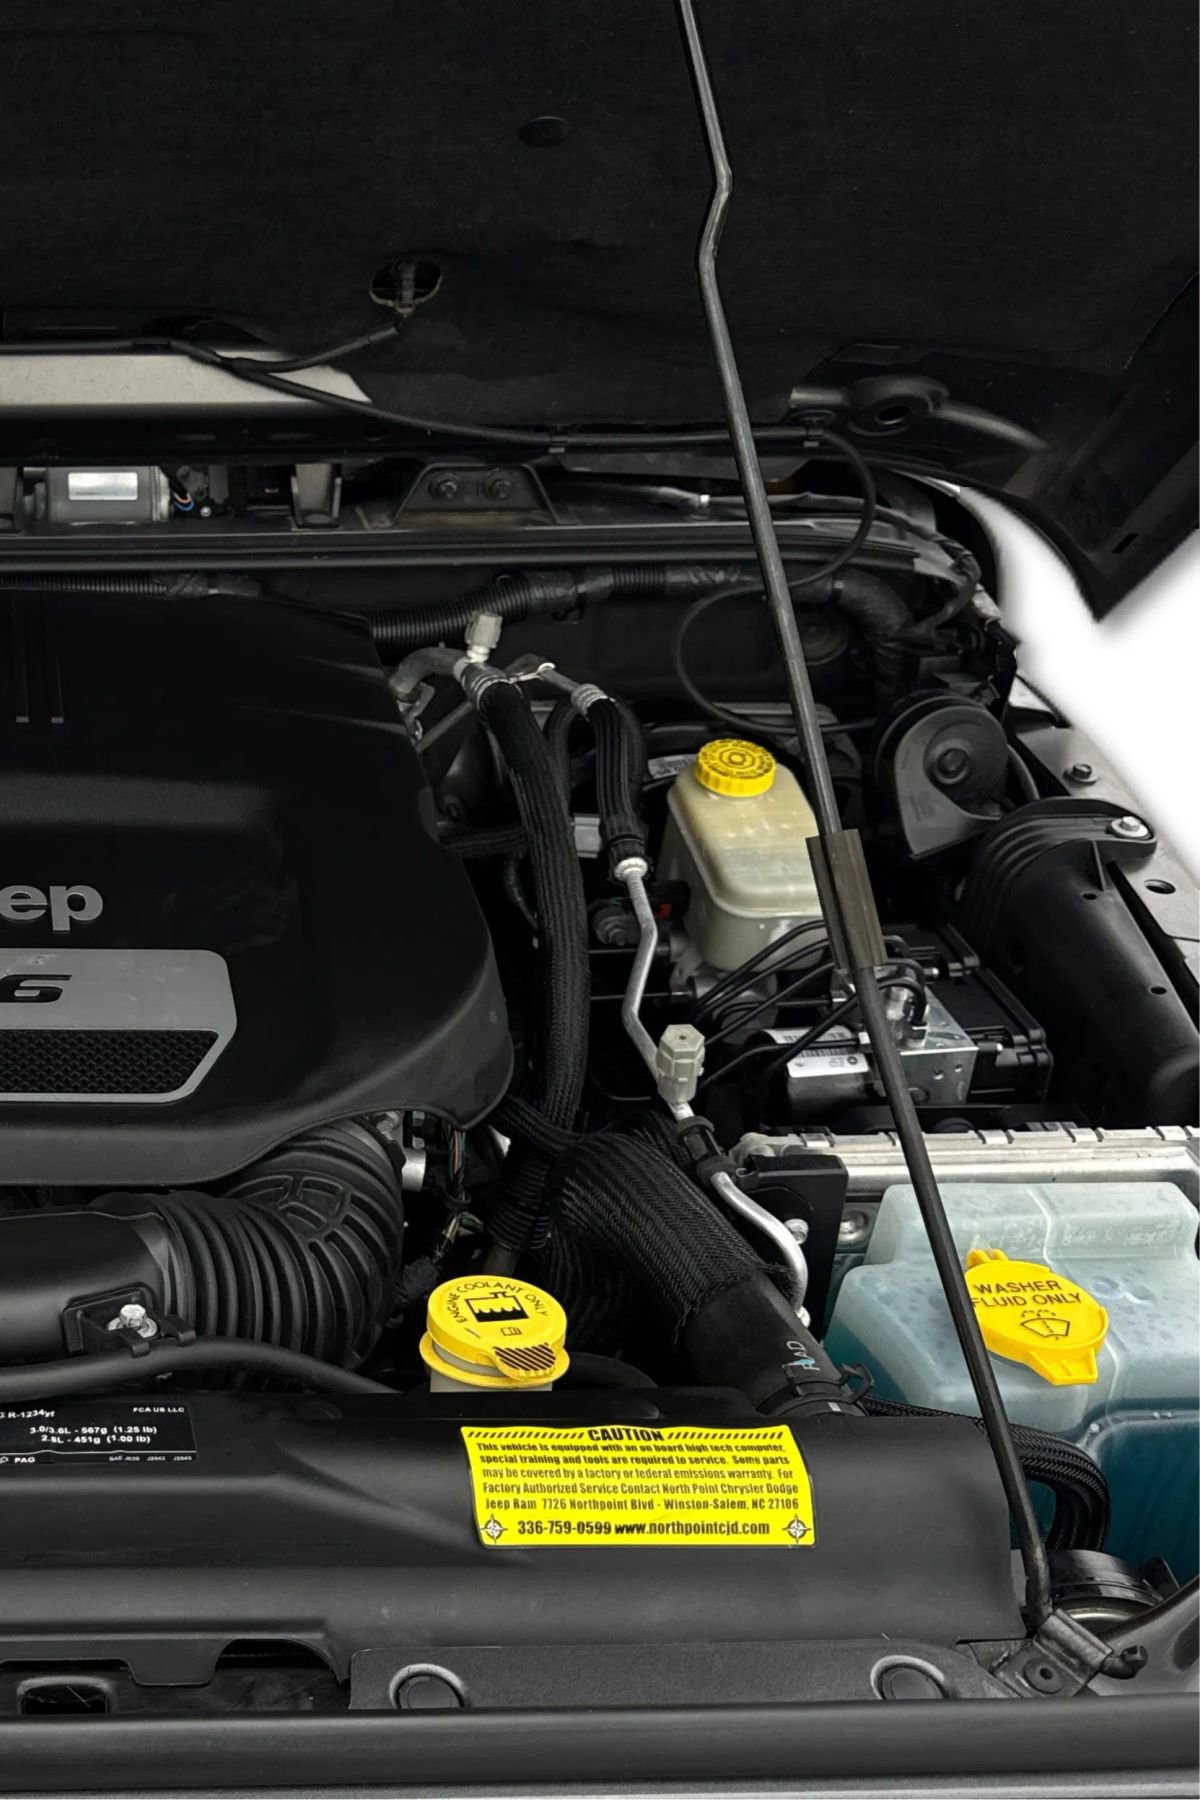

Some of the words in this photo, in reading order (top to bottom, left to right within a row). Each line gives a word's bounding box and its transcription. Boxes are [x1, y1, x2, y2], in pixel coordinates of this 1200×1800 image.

[456, 1281, 523, 1294] COOLANT
[973, 1280, 1062, 1294] WASHER
[525, 1293, 549, 1317] ONLY
[971, 1295, 1028, 1308] FLUID
[1033, 1292, 1082, 1306] ONLY
[446, 1292, 468, 1324] ENGINE
[8, 1409, 56, 1419] R-1234yf
[29, 1425, 72, 1434] 3.0/3.6L
[81, 1426, 108, 1435] 567g
[113, 1426, 140, 1434] (1.25
[142, 1426, 157, 1435] lb)
[588, 1428, 665, 1442] CAUTION
[41, 1434, 65, 1444] 2.8L
[74, 1436, 101, 1445] 451g
[106, 1435, 133, 1444] (1.00
[135, 1436, 151, 1444] lb)
[477, 1443, 499, 1451] This
[552, 1444, 599, 1452] equipped
[601, 1443, 623, 1451] with
[652, 1444, 683, 1452] board
[685, 1444, 708, 1452] high
[709, 1444, 733, 1452] tech
[480, 1455, 517, 1464] special
[519, 1455, 560, 1464] training
[563, 1455, 581, 1463] and
[583, 1455, 609, 1464] tools
[611, 1456, 628, 1464] are
[630, 1455, 675, 1465] required
[676, 1456, 686, 1464] to
[688, 1456, 729, 1464] service.
[733, 1456, 761, 1465] Some
[763, 1456, 790, 1465] parts
[482, 1469, 504, 1479] may
[506, 1468, 518, 1478] be
[520, 1468, 560, 1478] covered
[563, 1468, 576, 1479] by
[577, 1470, 583, 1478] a
[585, 1468, 621, 1480] factory
[623, 1470, 634, 1478] or
[635, 1469, 672, 1479] federal
[674, 1469, 726, 1479] emissions
[727, 1470, 775, 1480] warranty.
[777, 1469, 793, 1479] For
[483, 1482, 521, 1495] Factory
[523, 1482, 578, 1494] Authorized
[579, 1483, 618, 1494] Service
[621, 1483, 661, 1495] Contact
[662, 1484, 690, 1495] North
[692, 1484, 719, 1494] Point
[721, 1483, 765, 1495] Chrysler
[767, 1484, 799, 1495] Dodge
[486, 1498, 510, 1510] Jeep
[513, 1499, 537, 1509] Ram
[542, 1499, 567, 1510] 7726
[570, 1499, 628, 1510] Northpoint
[631, 1499, 654, 1510] Blvd
[664, 1499, 749, 1511] Winston-Salem,
[752, 1499, 766, 1510] NC
[768, 1499, 799, 1510] 27106
[517, 1520, 612, 1535] 336-759-0599
[615, 1520, 770, 1536] www.northpointcjd.com
